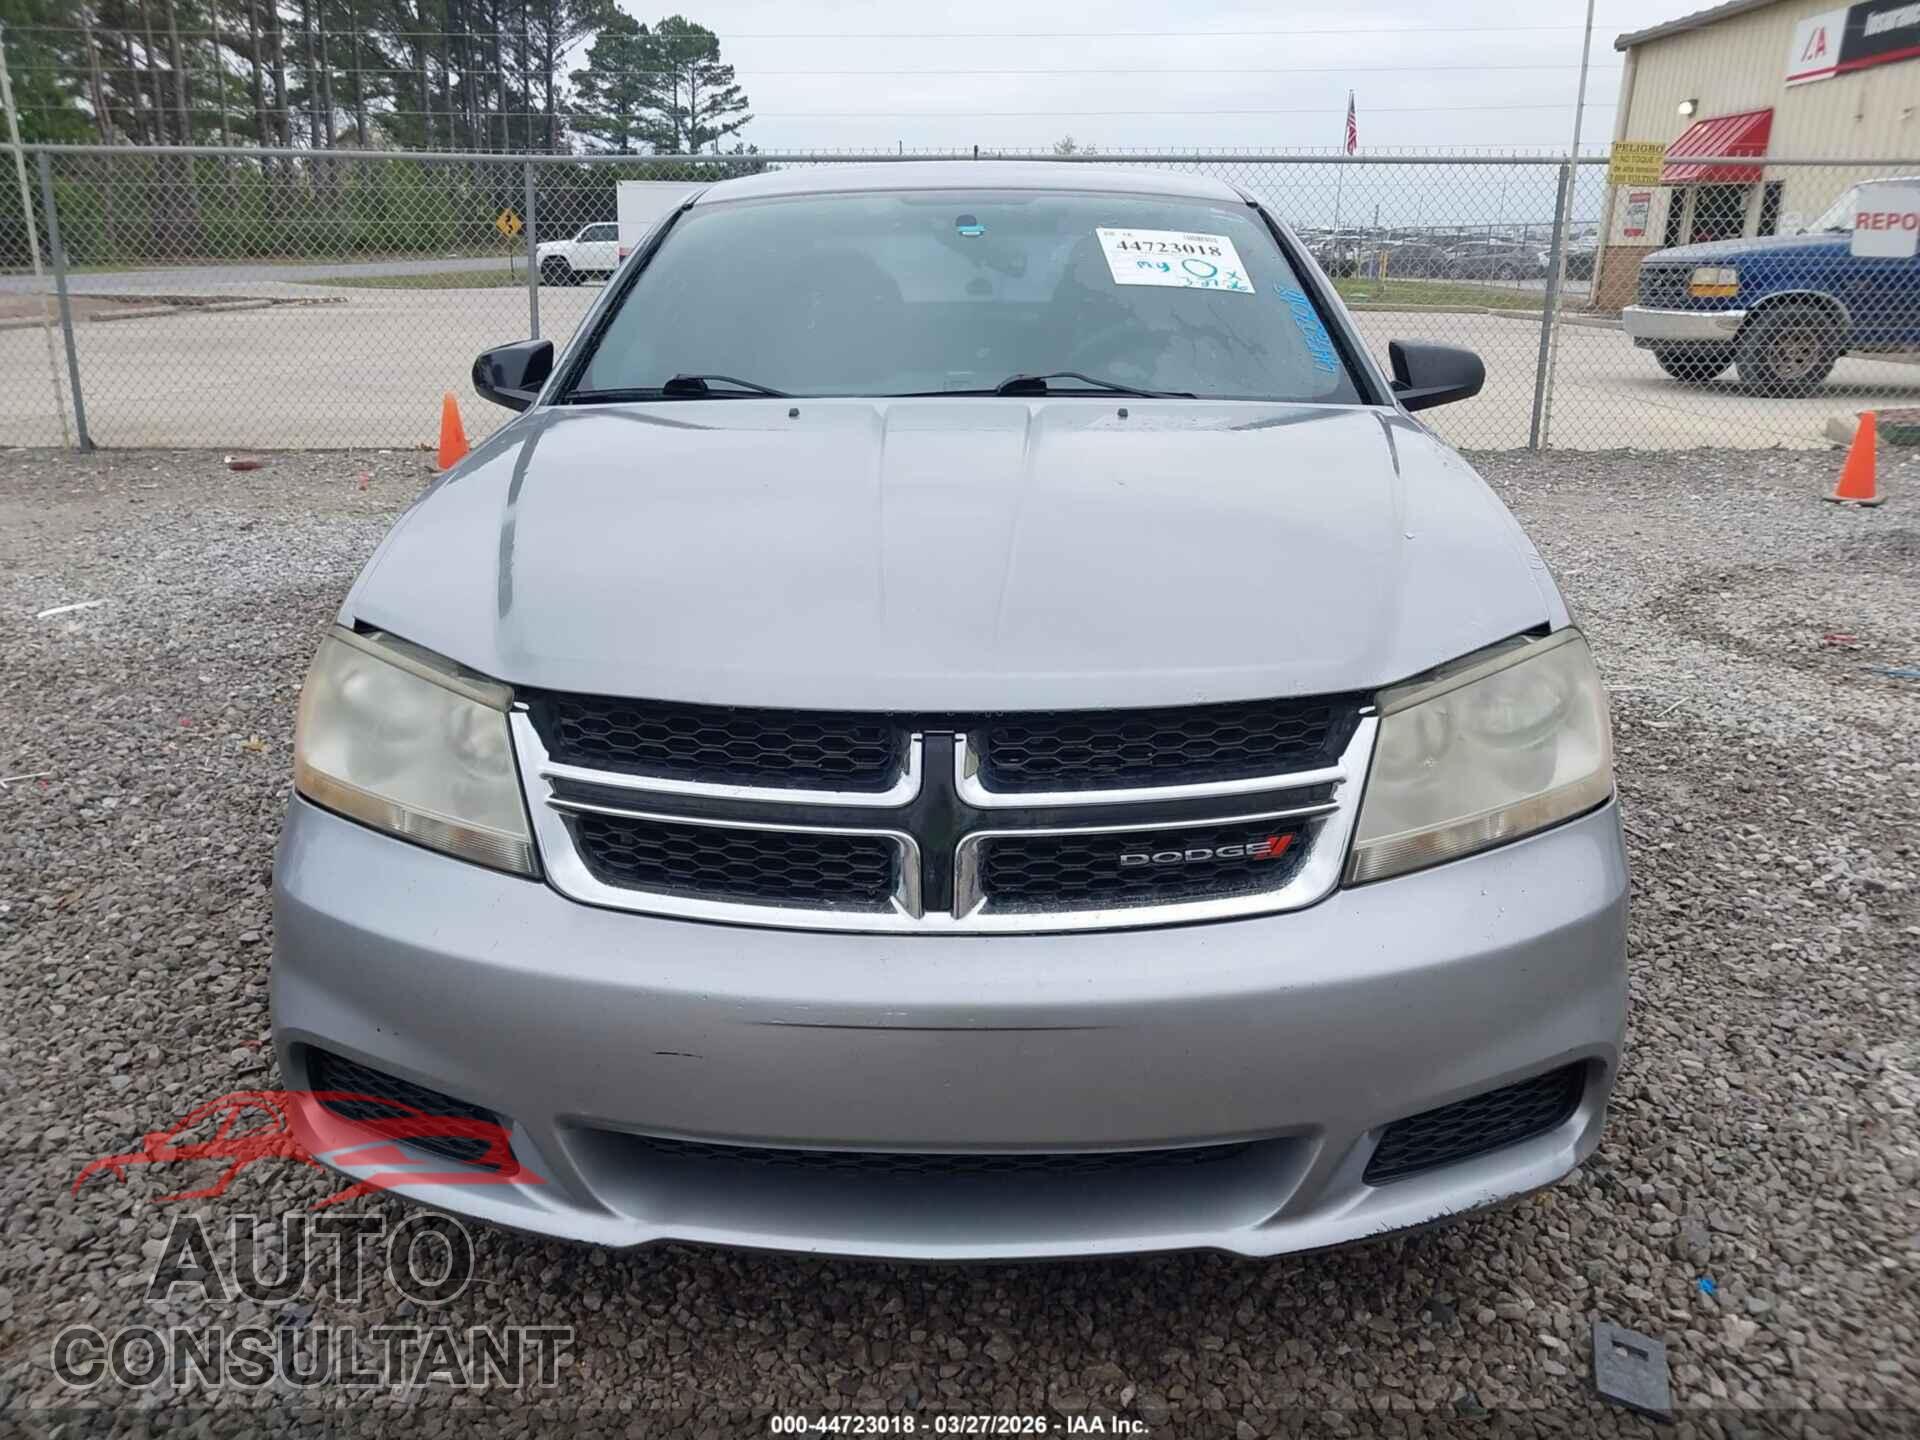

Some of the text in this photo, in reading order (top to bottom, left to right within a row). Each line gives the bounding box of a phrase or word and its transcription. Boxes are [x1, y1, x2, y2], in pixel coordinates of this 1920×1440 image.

[1855, 212, 1917, 230] REPO
[1117, 240, 1222, 257] 44723018
[1120, 841, 1272, 866] DODGE
